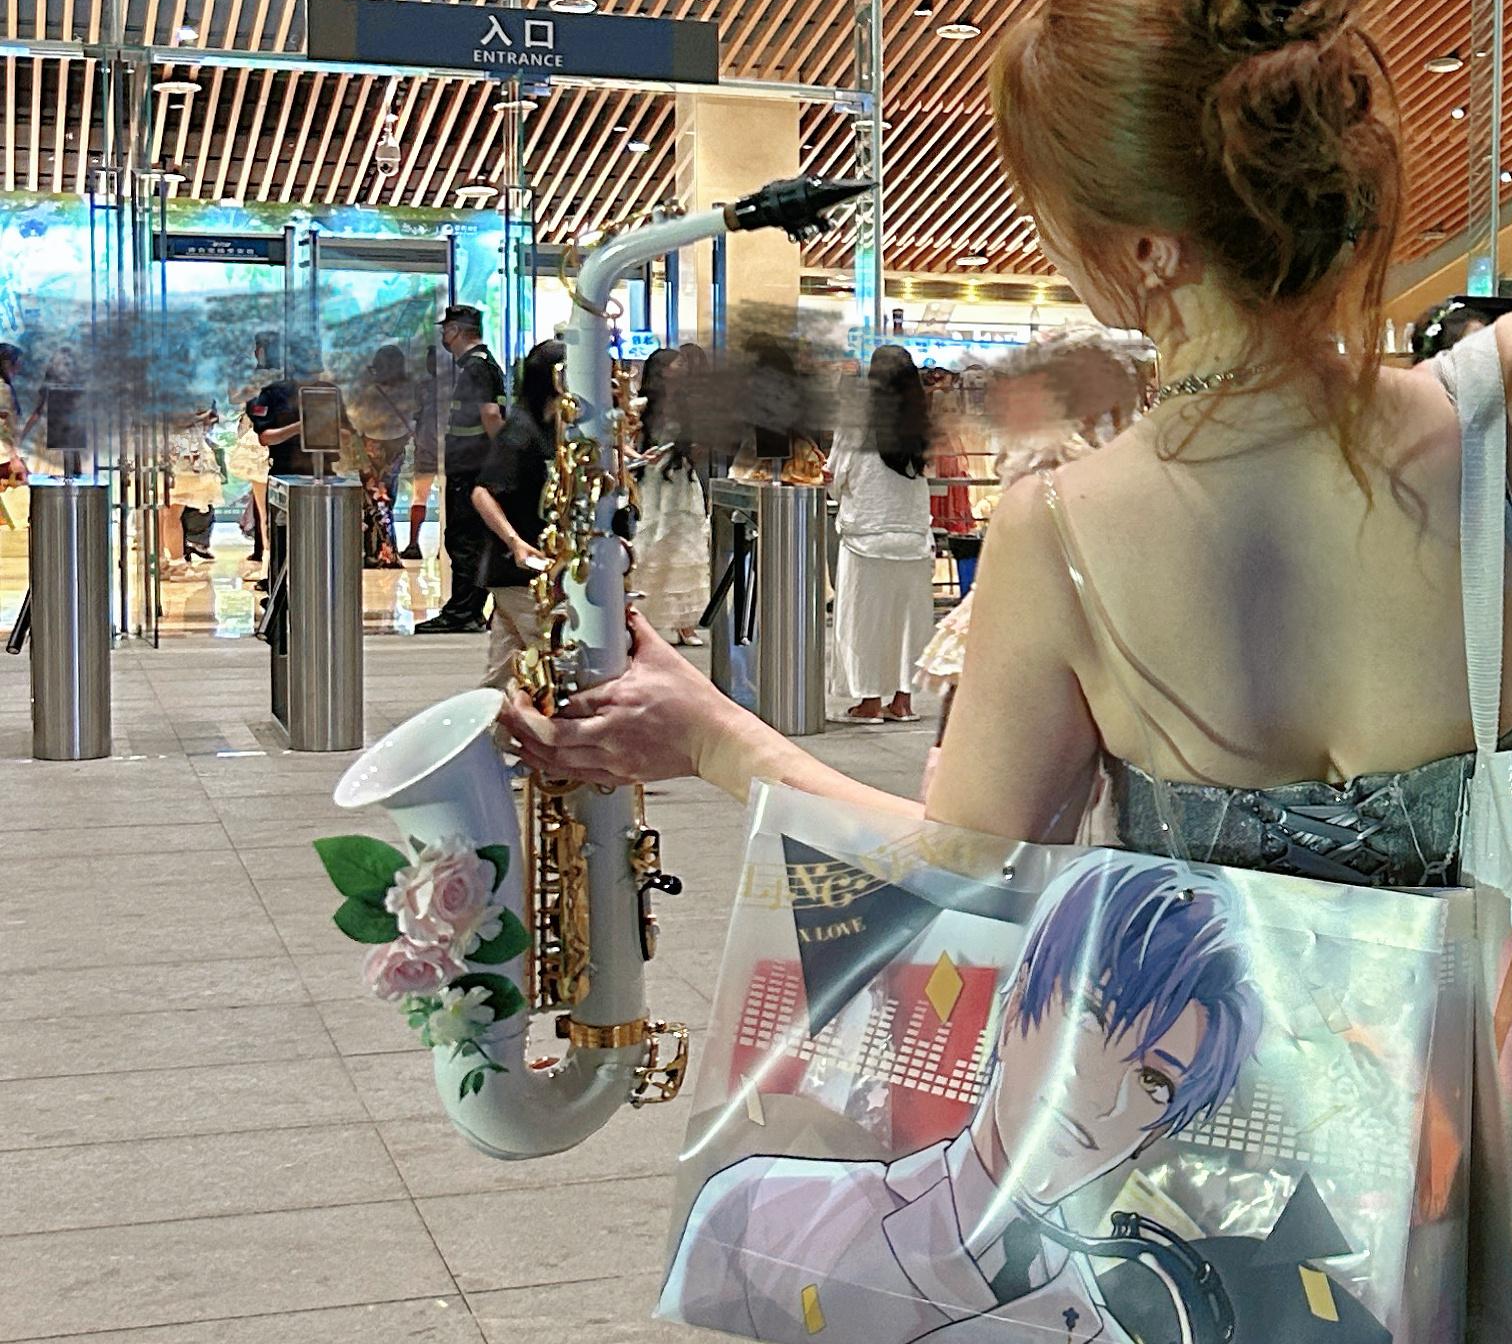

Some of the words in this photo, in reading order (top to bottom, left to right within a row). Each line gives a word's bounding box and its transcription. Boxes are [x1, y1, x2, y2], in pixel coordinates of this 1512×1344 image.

[480, 15, 554, 49] 入口
[473, 49, 564, 67] ENTRANCE
[815, 916, 867, 942] LOVE
